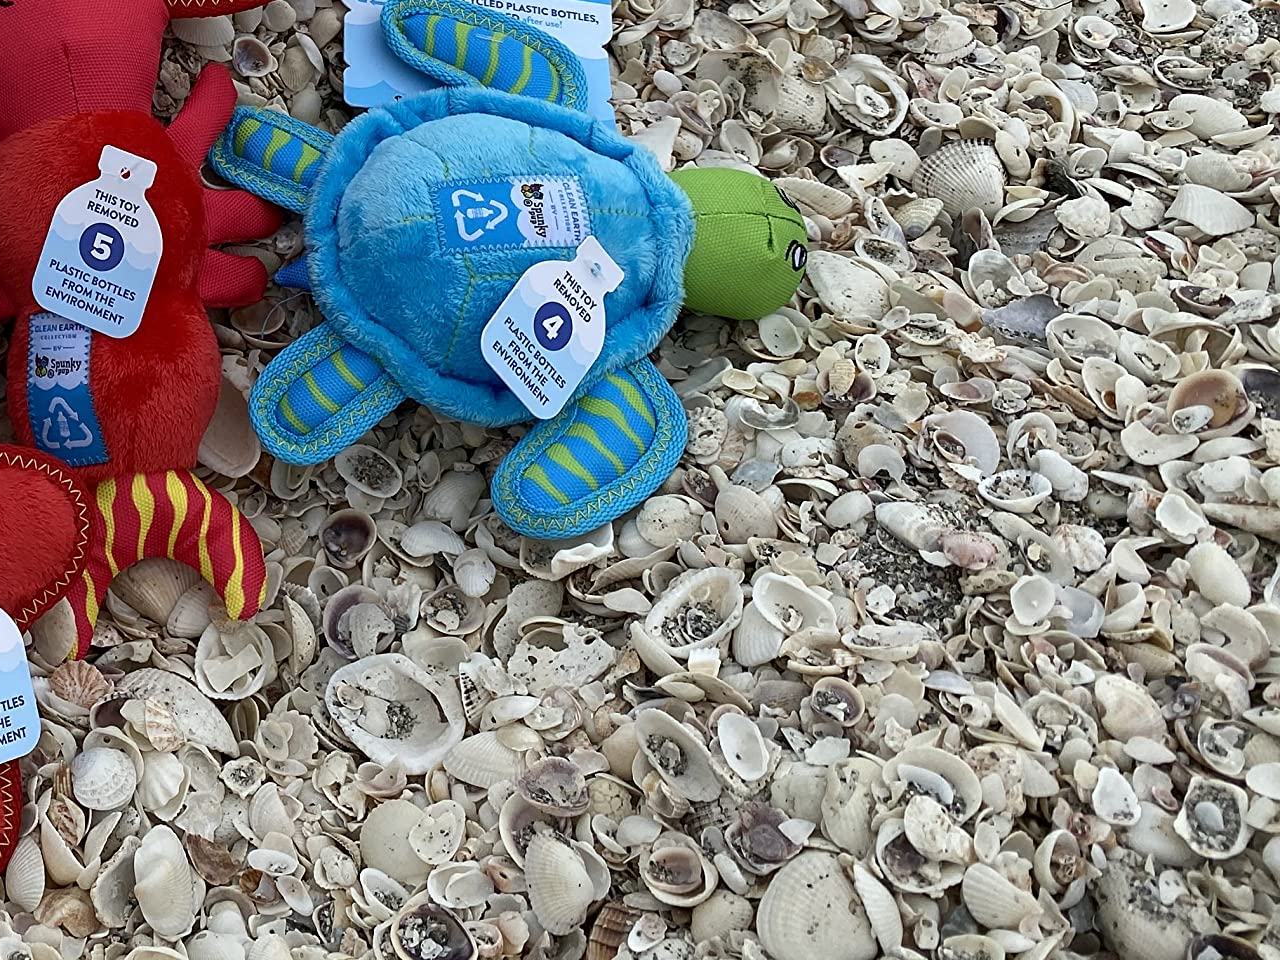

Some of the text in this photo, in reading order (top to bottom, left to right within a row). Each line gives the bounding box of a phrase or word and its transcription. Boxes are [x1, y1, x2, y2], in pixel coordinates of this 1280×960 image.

[506, 2, 549, 16] PLASTIC
[551, 9, 599, 25] BOTTLES,
[522, 16, 544, 26] after
[545, 19, 563, 29] use!
[86, 200, 139, 228] REMOVED
[95, 189, 140, 214] THIS TOY
[562, 182, 581, 241] CLEAN EARTH
[528, 210, 537, 224] pup
[531, 202, 548, 238] Spunky
[90, 232, 114, 261] 5
[49, 259, 136, 302] PLASTIC BOTTLES
[61, 278, 116, 308] FROM THE
[563, 271, 597, 310] THIS TOY
[45, 286, 124, 325] ENVIRONMENT
[553, 278, 591, 323] REMOVED
[34, 323, 85, 333] CLEAN EARTH
[542, 315, 564, 340] 4
[50, 357, 82, 372] Spunky
[504, 317, 566, 389] PLASTIC BOTTLES
[508, 340, 548, 387] FROM THE
[57, 368, 70, 376] pup
[492, 340, 550, 406] ENVIRONMENT
